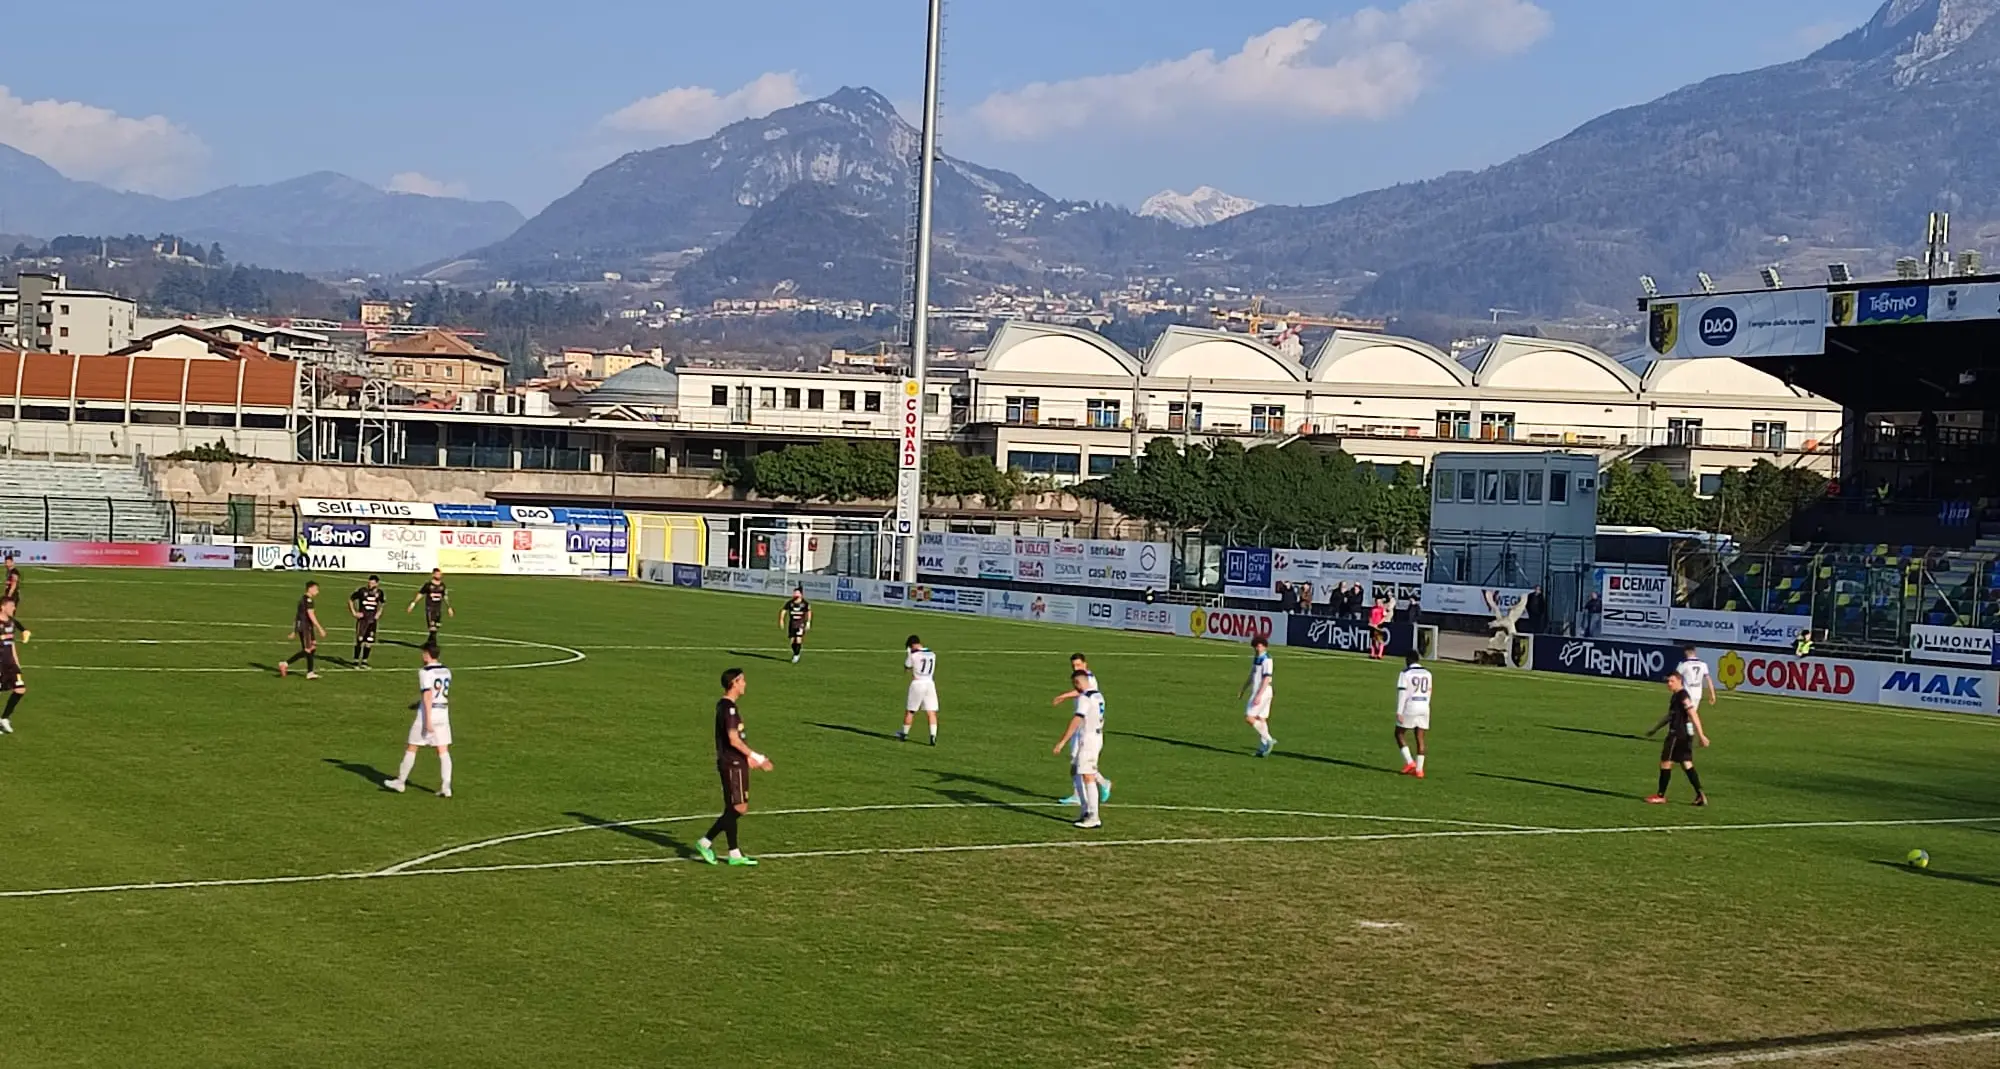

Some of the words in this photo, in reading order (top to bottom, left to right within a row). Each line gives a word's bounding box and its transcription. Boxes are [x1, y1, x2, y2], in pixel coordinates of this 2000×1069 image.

[1869, 294, 1917, 312] TRENTINO
[1704, 317, 1734, 334] DAO
[904, 399, 917, 466] CONAD
[309, 525, 365, 545] TRENTINO
[1622, 577, 1667, 592] CEMIAT
[1208, 612, 1273, 640] CONAD
[1326, 619, 1391, 651] TRENTIO
[1924, 634, 1992, 649] LIMONTA
[1582, 641, 1665, 678] TRENTINO
[1411, 675, 1429, 694] 90
[1747, 658, 1855, 695] CONAD
[1882, 670, 1982, 699] MAK
[433, 677, 451, 698] 98
